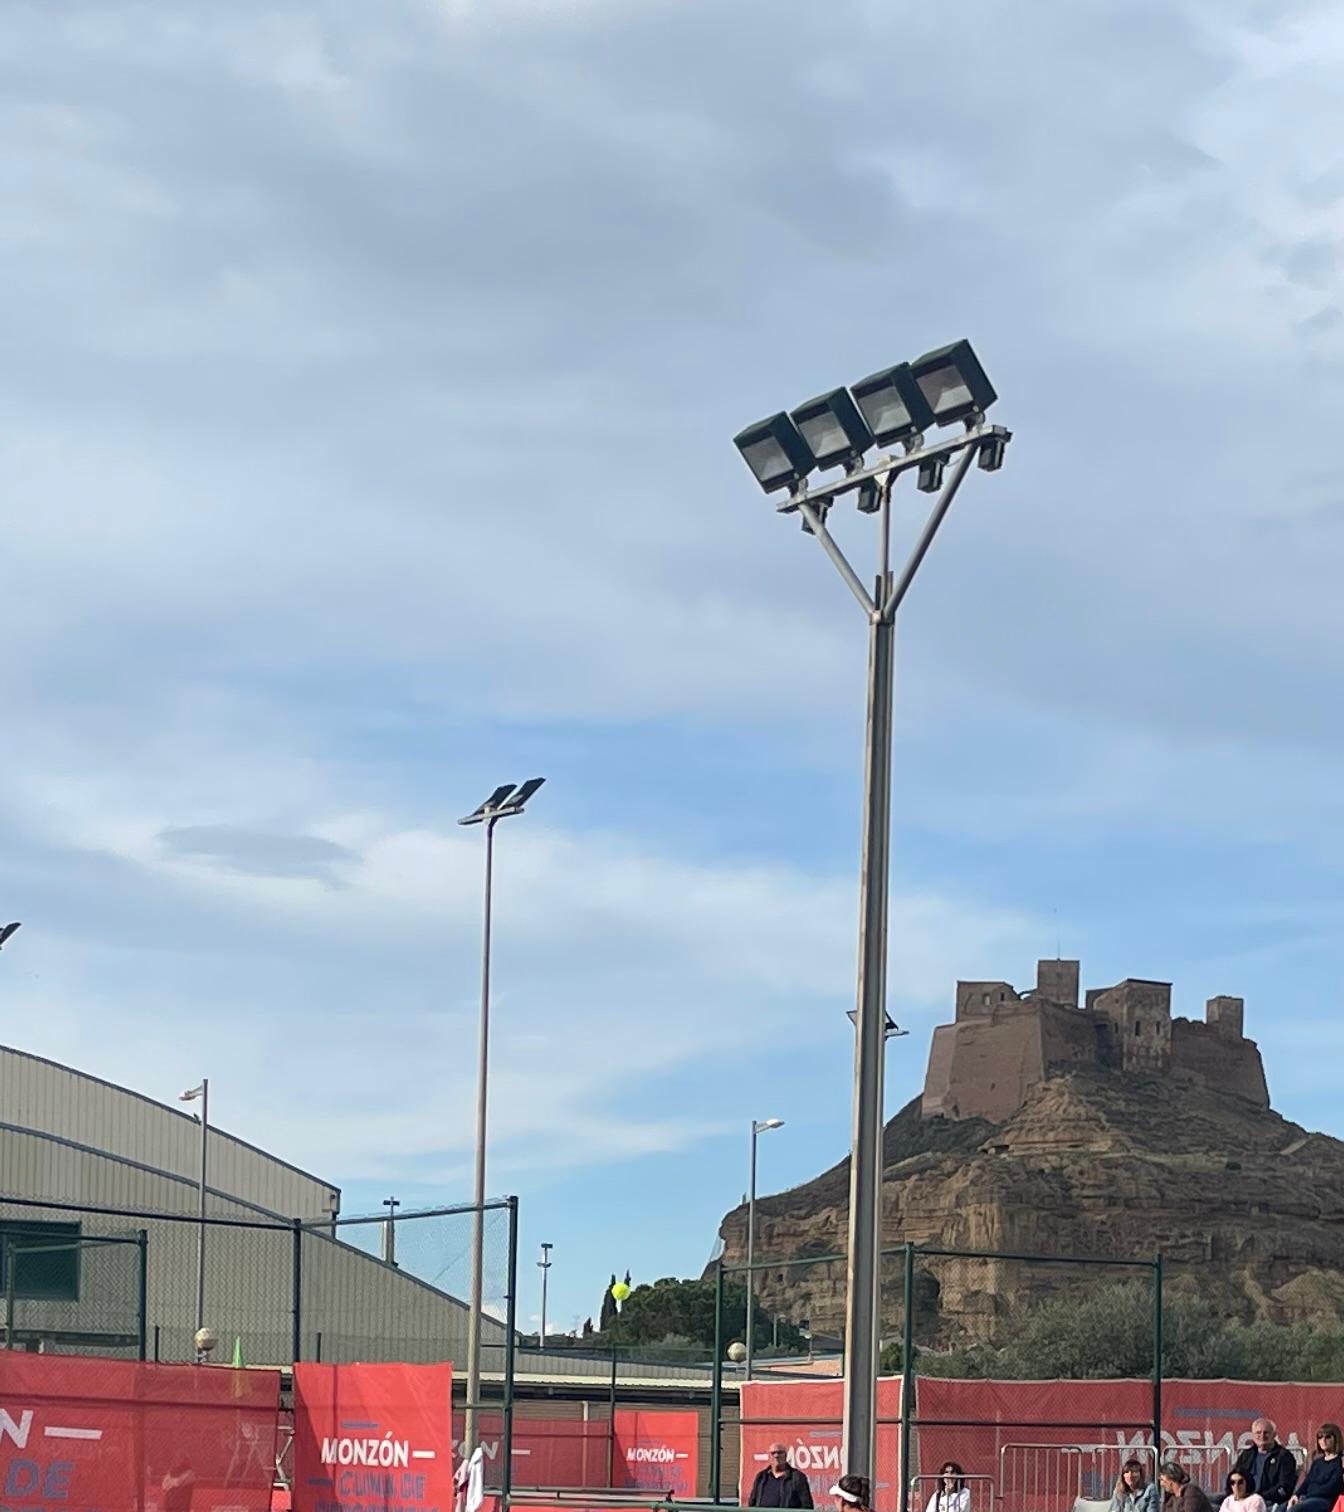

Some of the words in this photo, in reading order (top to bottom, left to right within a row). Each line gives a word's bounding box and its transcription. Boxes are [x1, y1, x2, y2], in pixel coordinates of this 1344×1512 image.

[321, 1431, 409, 1468] MONZÓN
[625, 1444, 675, 1463] MONZÓN
[6, 1458, 76, 1499] DE
